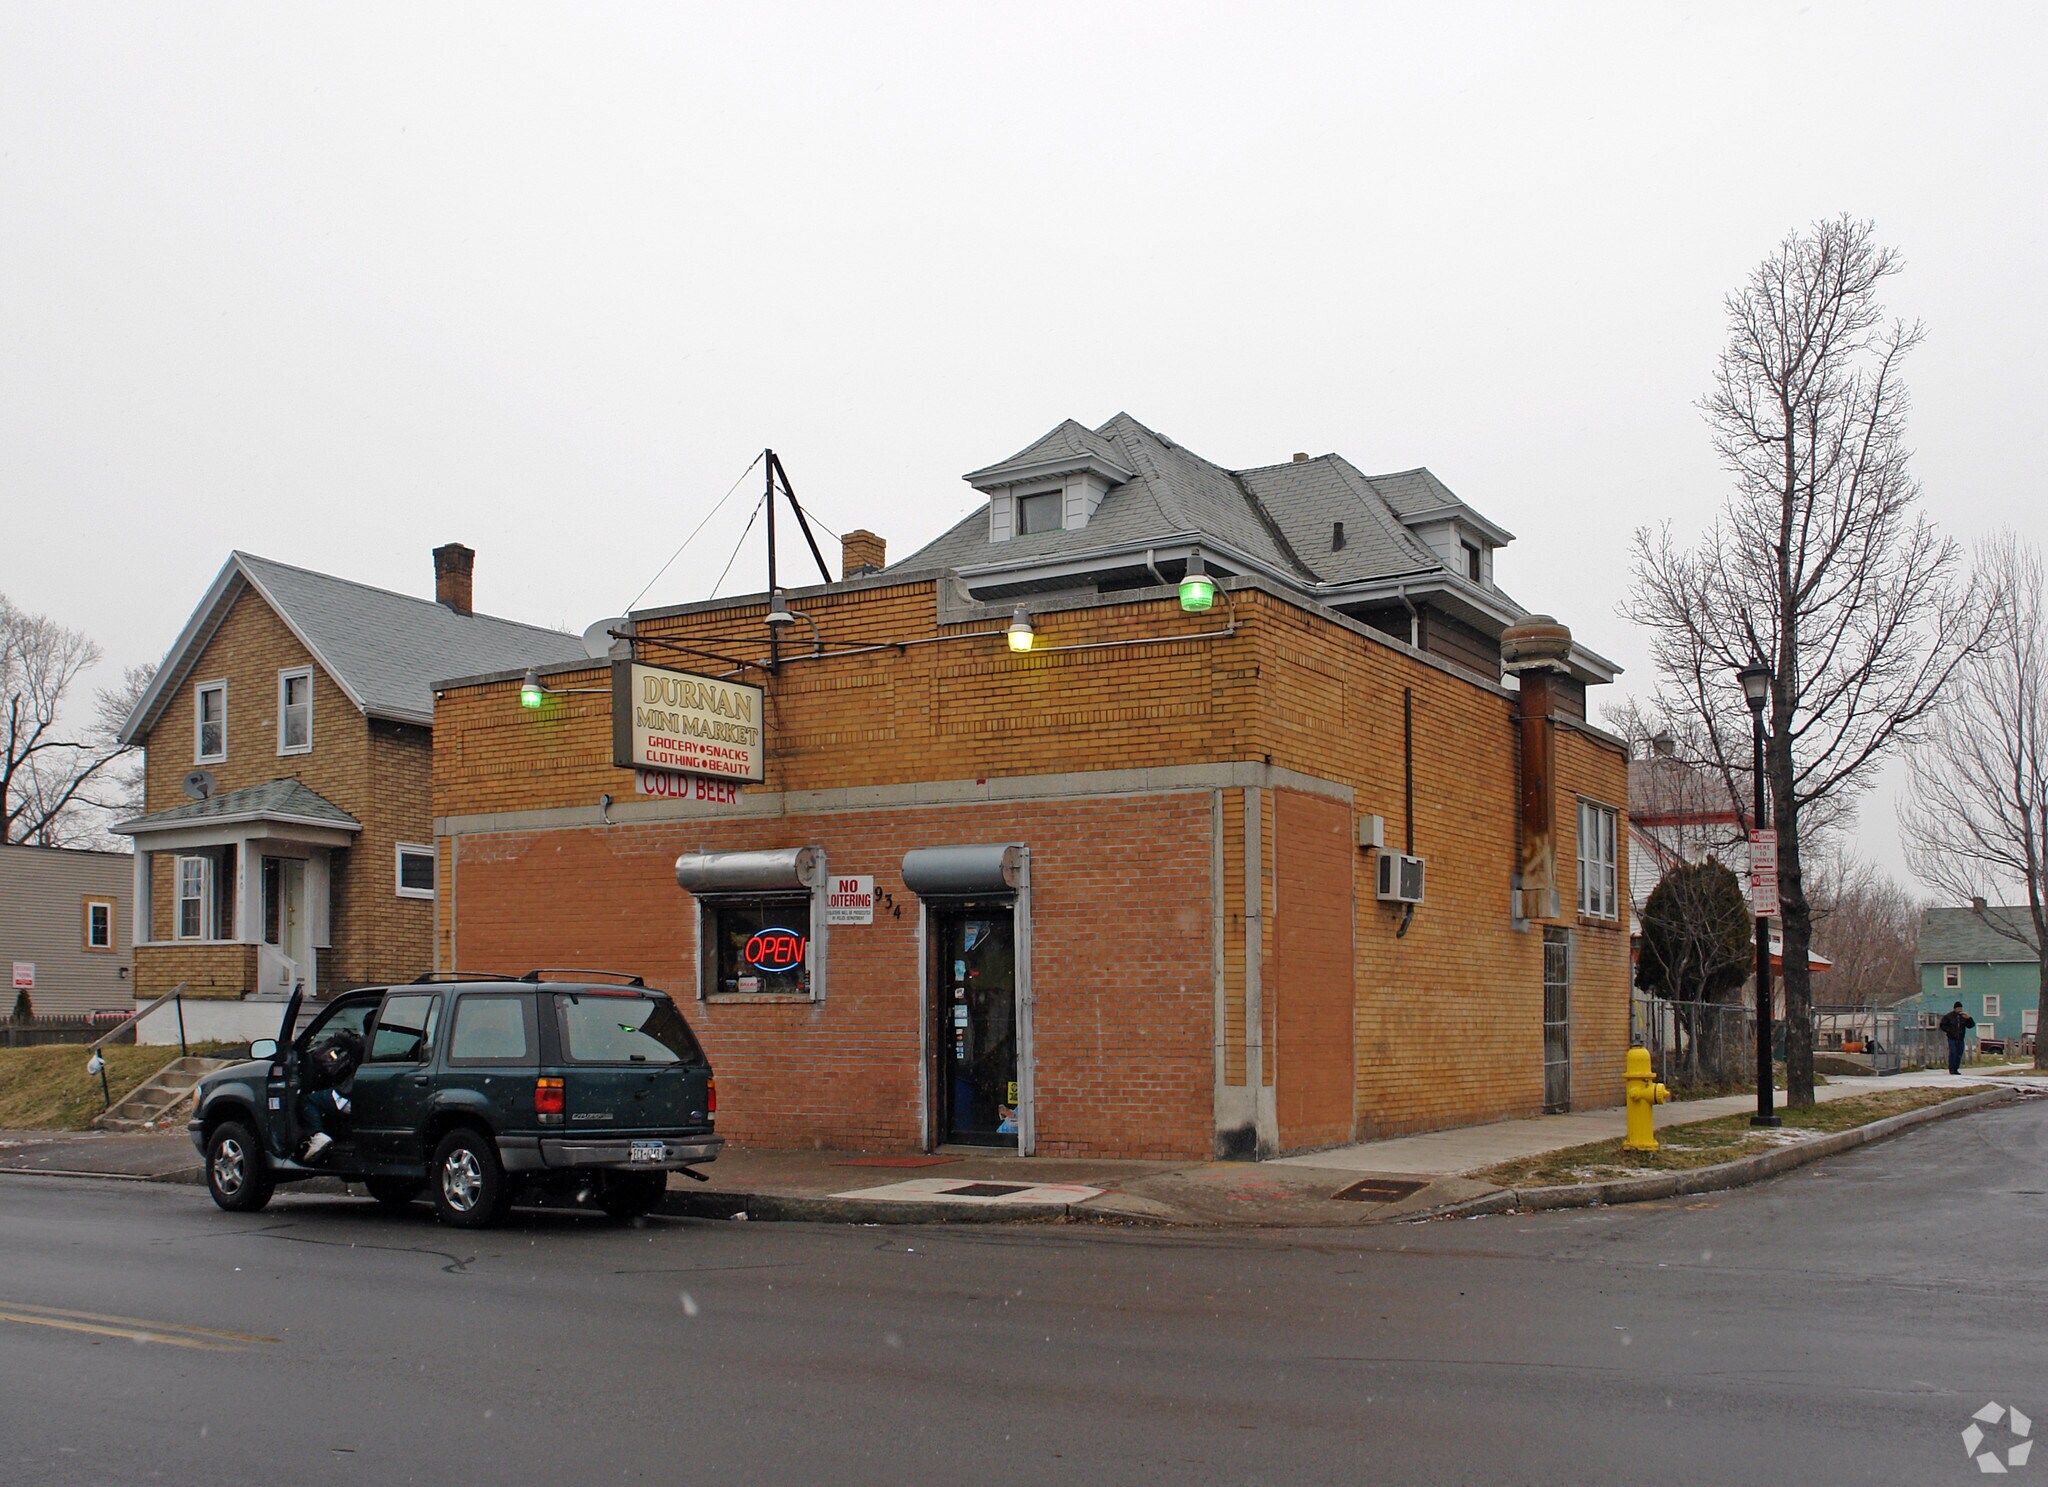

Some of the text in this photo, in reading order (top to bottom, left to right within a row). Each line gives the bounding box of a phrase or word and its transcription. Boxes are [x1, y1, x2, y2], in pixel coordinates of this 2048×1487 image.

[643, 676, 752, 722] DURNAN
[637, 707, 758, 746] MINI MARKET
[646, 749, 751, 775] CLOTHING BEAUTY
[648, 735, 749, 762] GROCERY SNACKS
[643, 770, 737, 804] COLD BEER
[839, 879, 858, 893] NO
[745, 937, 805, 963] OPEN
